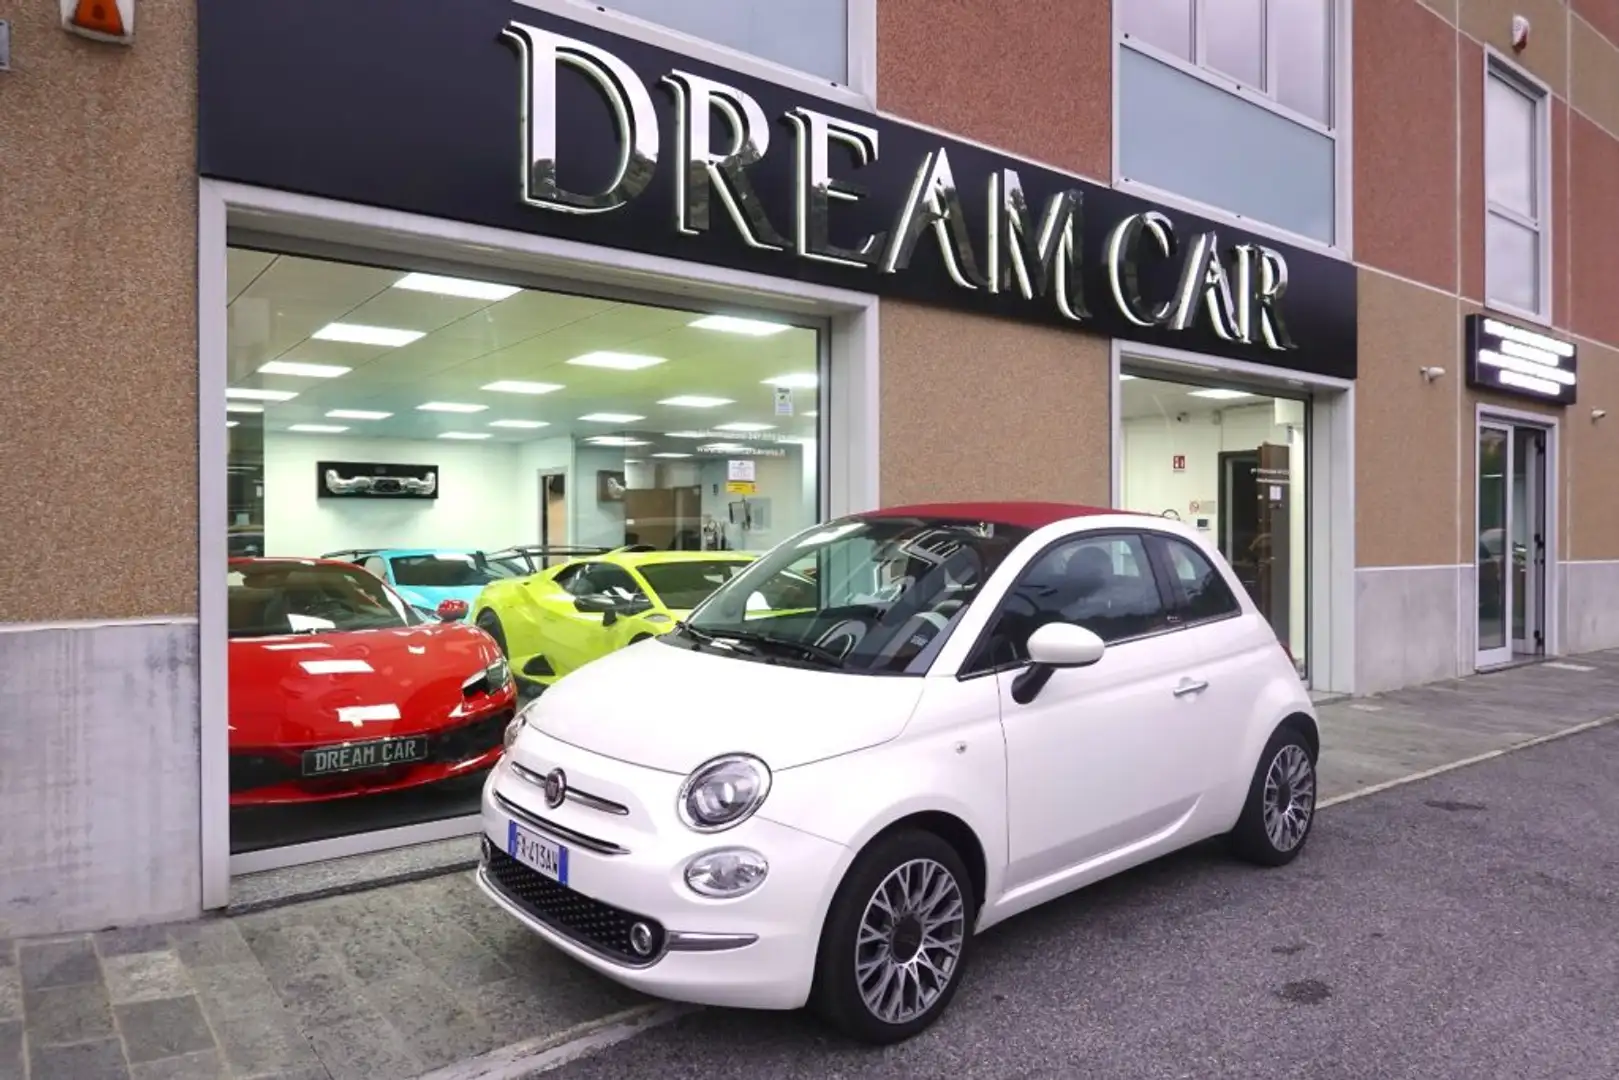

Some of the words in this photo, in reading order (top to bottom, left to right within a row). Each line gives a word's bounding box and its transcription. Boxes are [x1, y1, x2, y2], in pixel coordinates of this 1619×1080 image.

[501, 20, 1092, 321] DREAM
[1107, 209, 1298, 351] CAR
[315, 745, 376, 772] DREAM
[381, 740, 416, 761] CAR
